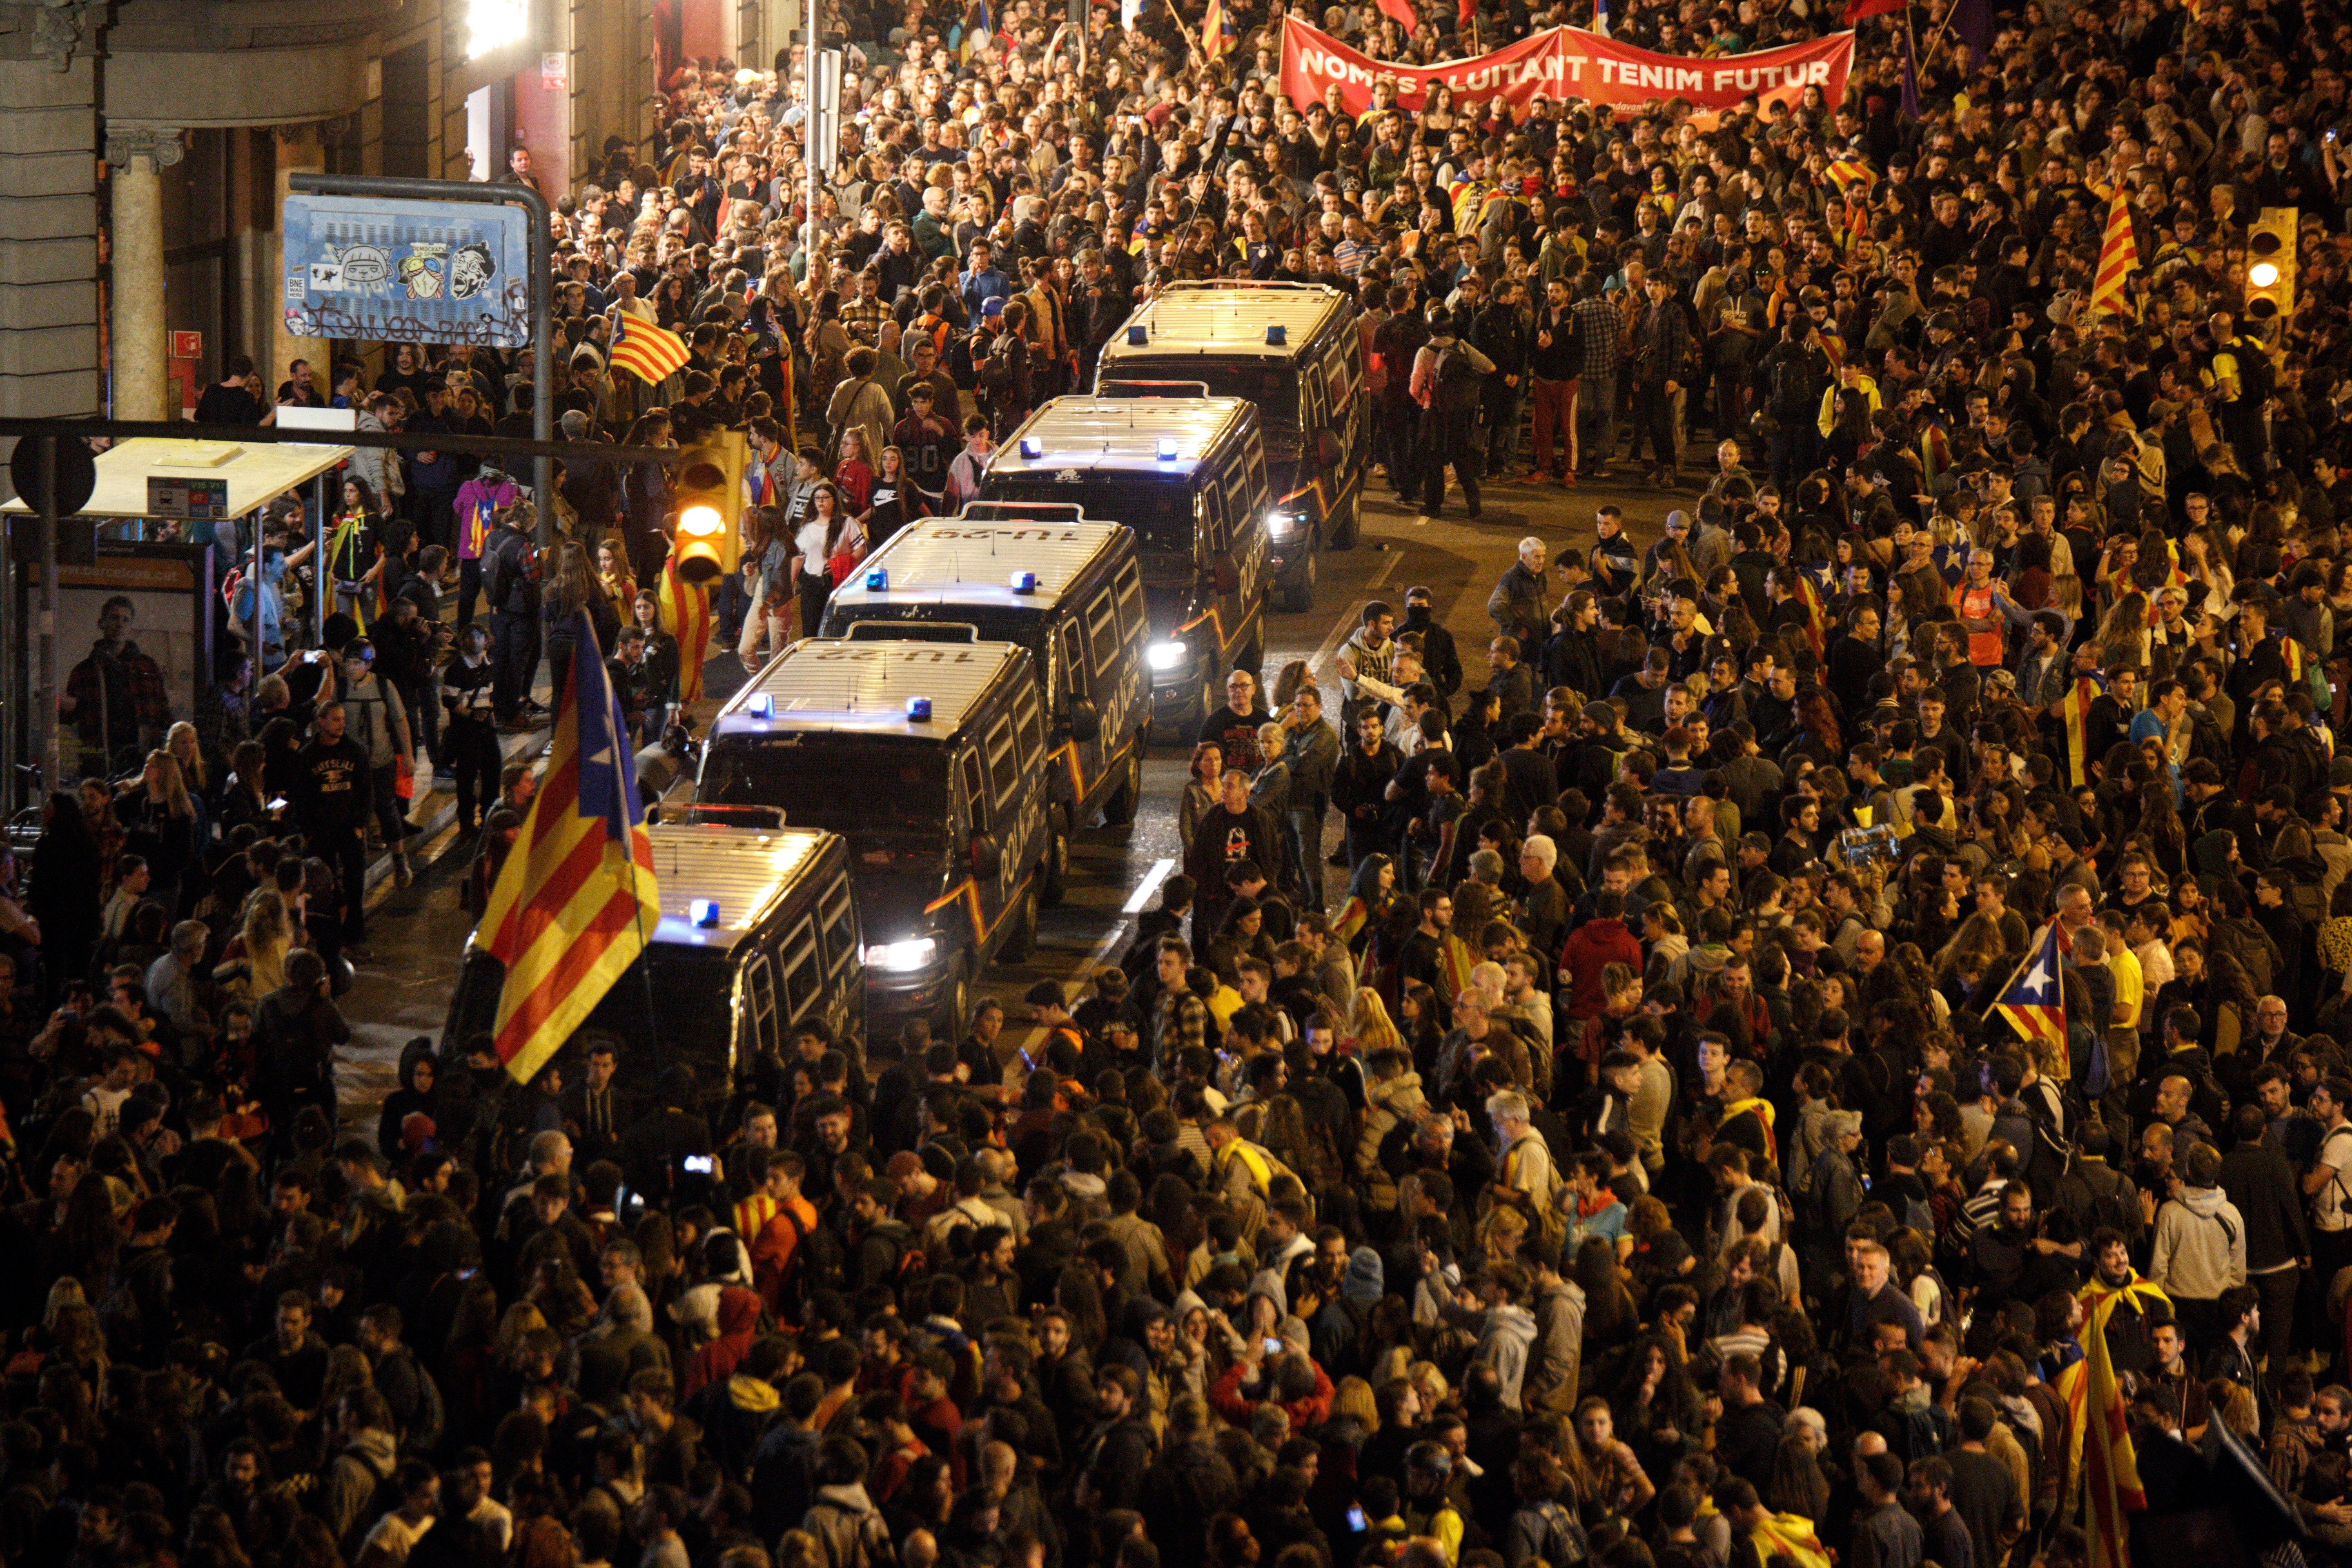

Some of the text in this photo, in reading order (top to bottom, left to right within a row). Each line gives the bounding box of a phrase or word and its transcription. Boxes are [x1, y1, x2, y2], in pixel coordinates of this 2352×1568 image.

[1300, 48, 1417, 94] NOMÉS
[1597, 58, 1703, 91] TENIM
[1714, 61, 1830, 91] FUTUR
[290, 279, 302, 287] BNE
[875, 489, 896, 499] NIKE
[816, 649, 974, 663] 1U-22
